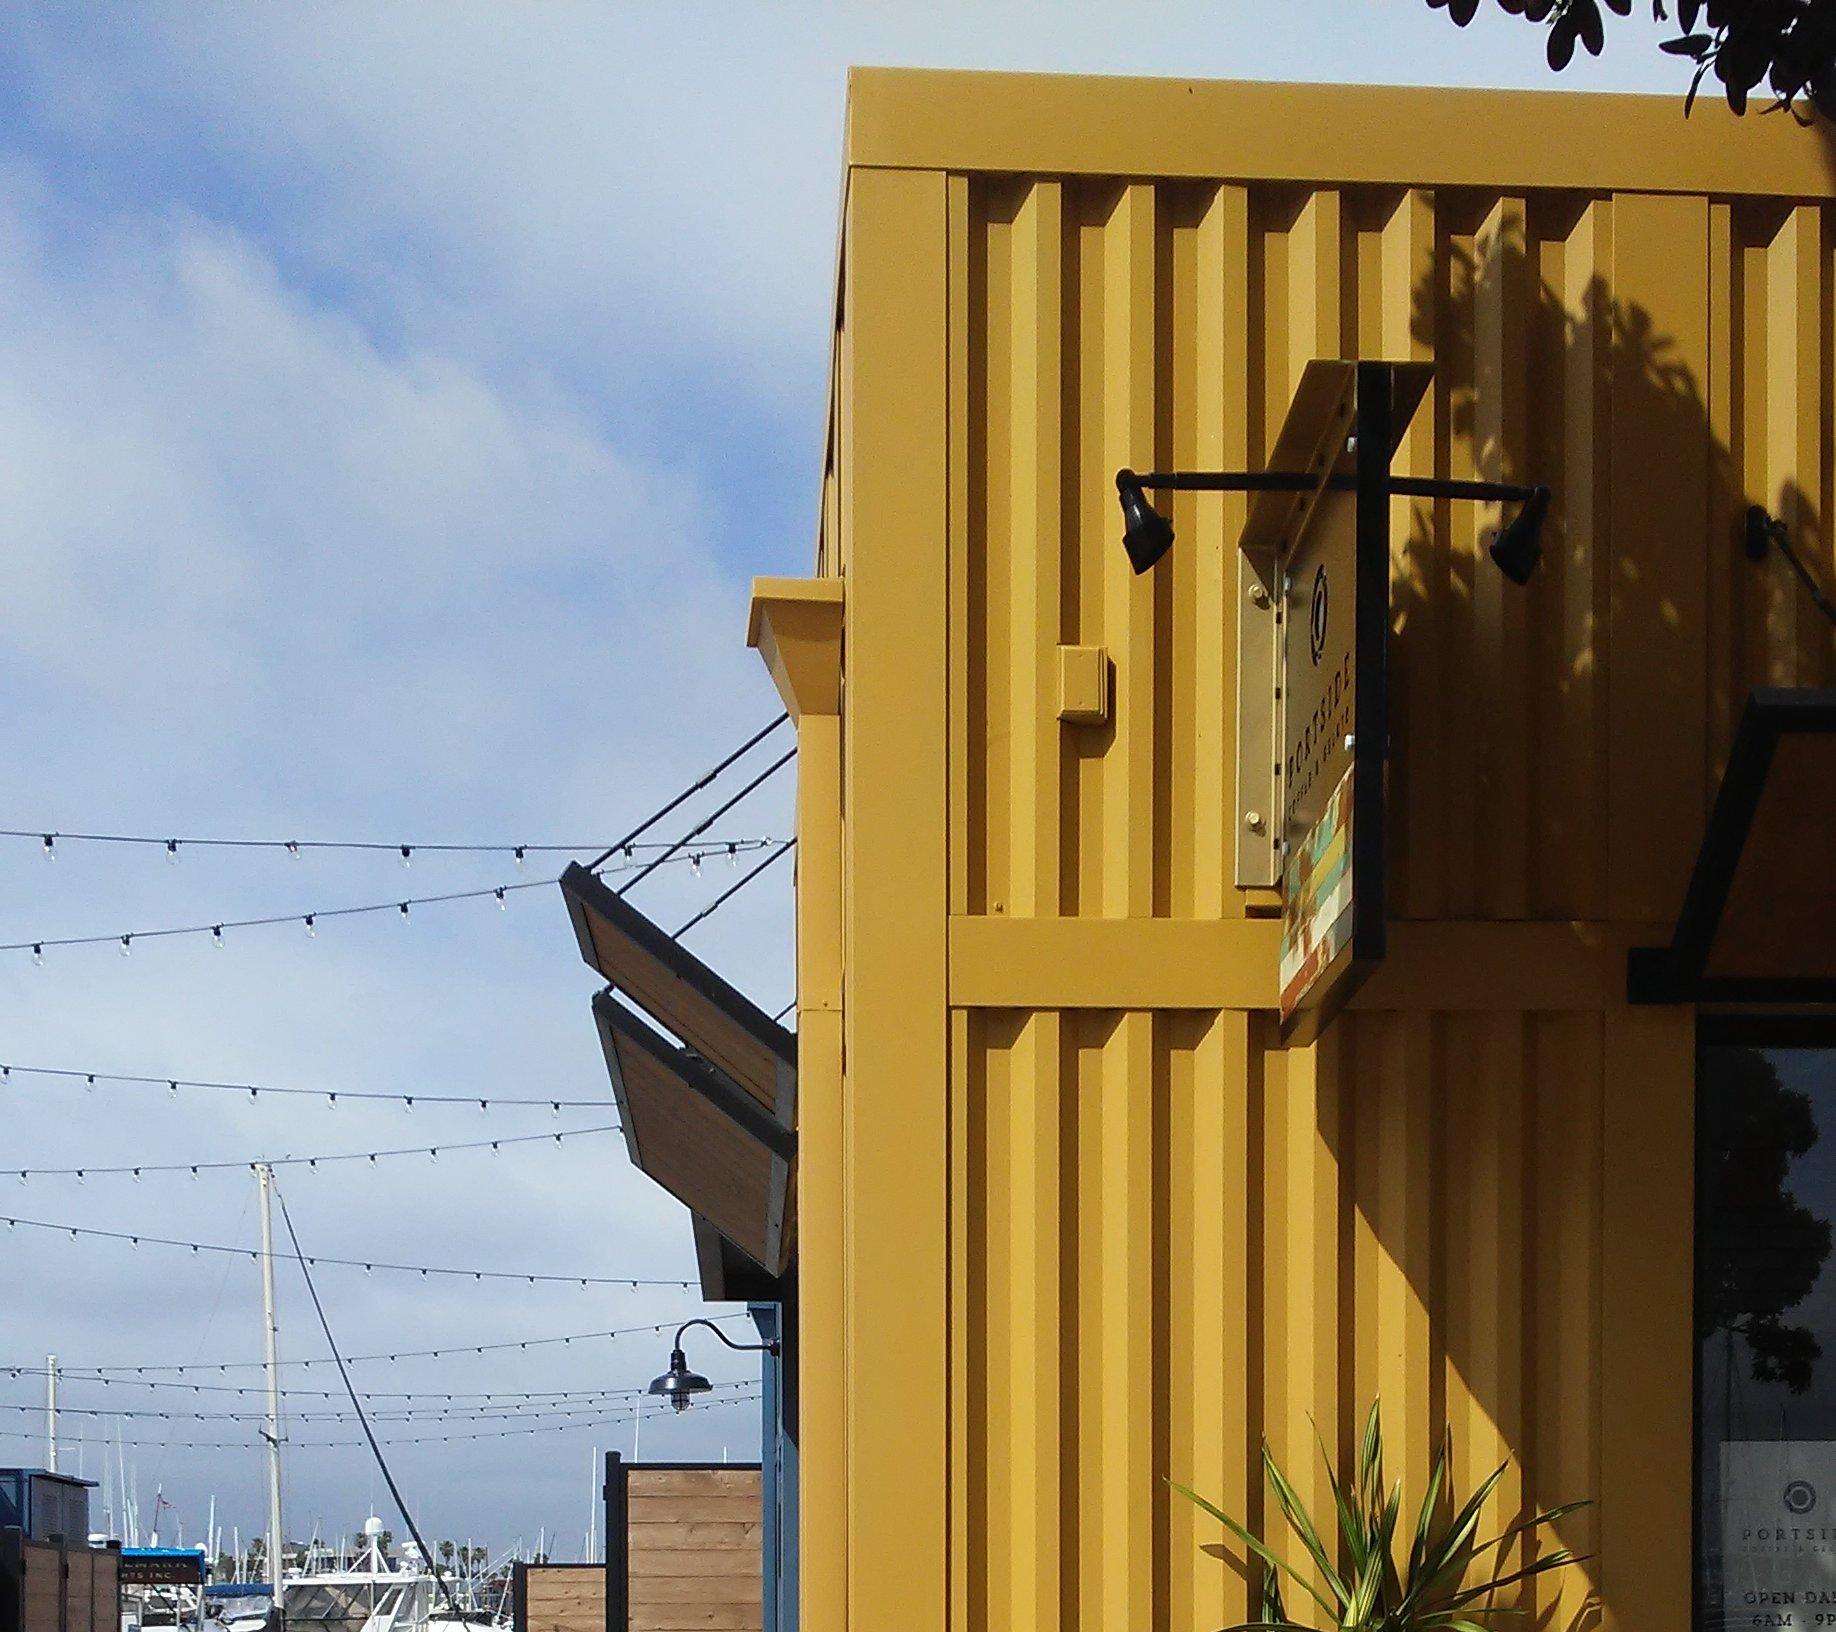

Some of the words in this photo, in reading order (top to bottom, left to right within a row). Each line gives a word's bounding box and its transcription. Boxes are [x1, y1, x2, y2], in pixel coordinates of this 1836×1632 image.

[1288, 651, 1350, 789] PORTSIDE
[1744, 1591, 1795, 1604] OPEN
[1752, 1613, 1792, 1627] 6AM
